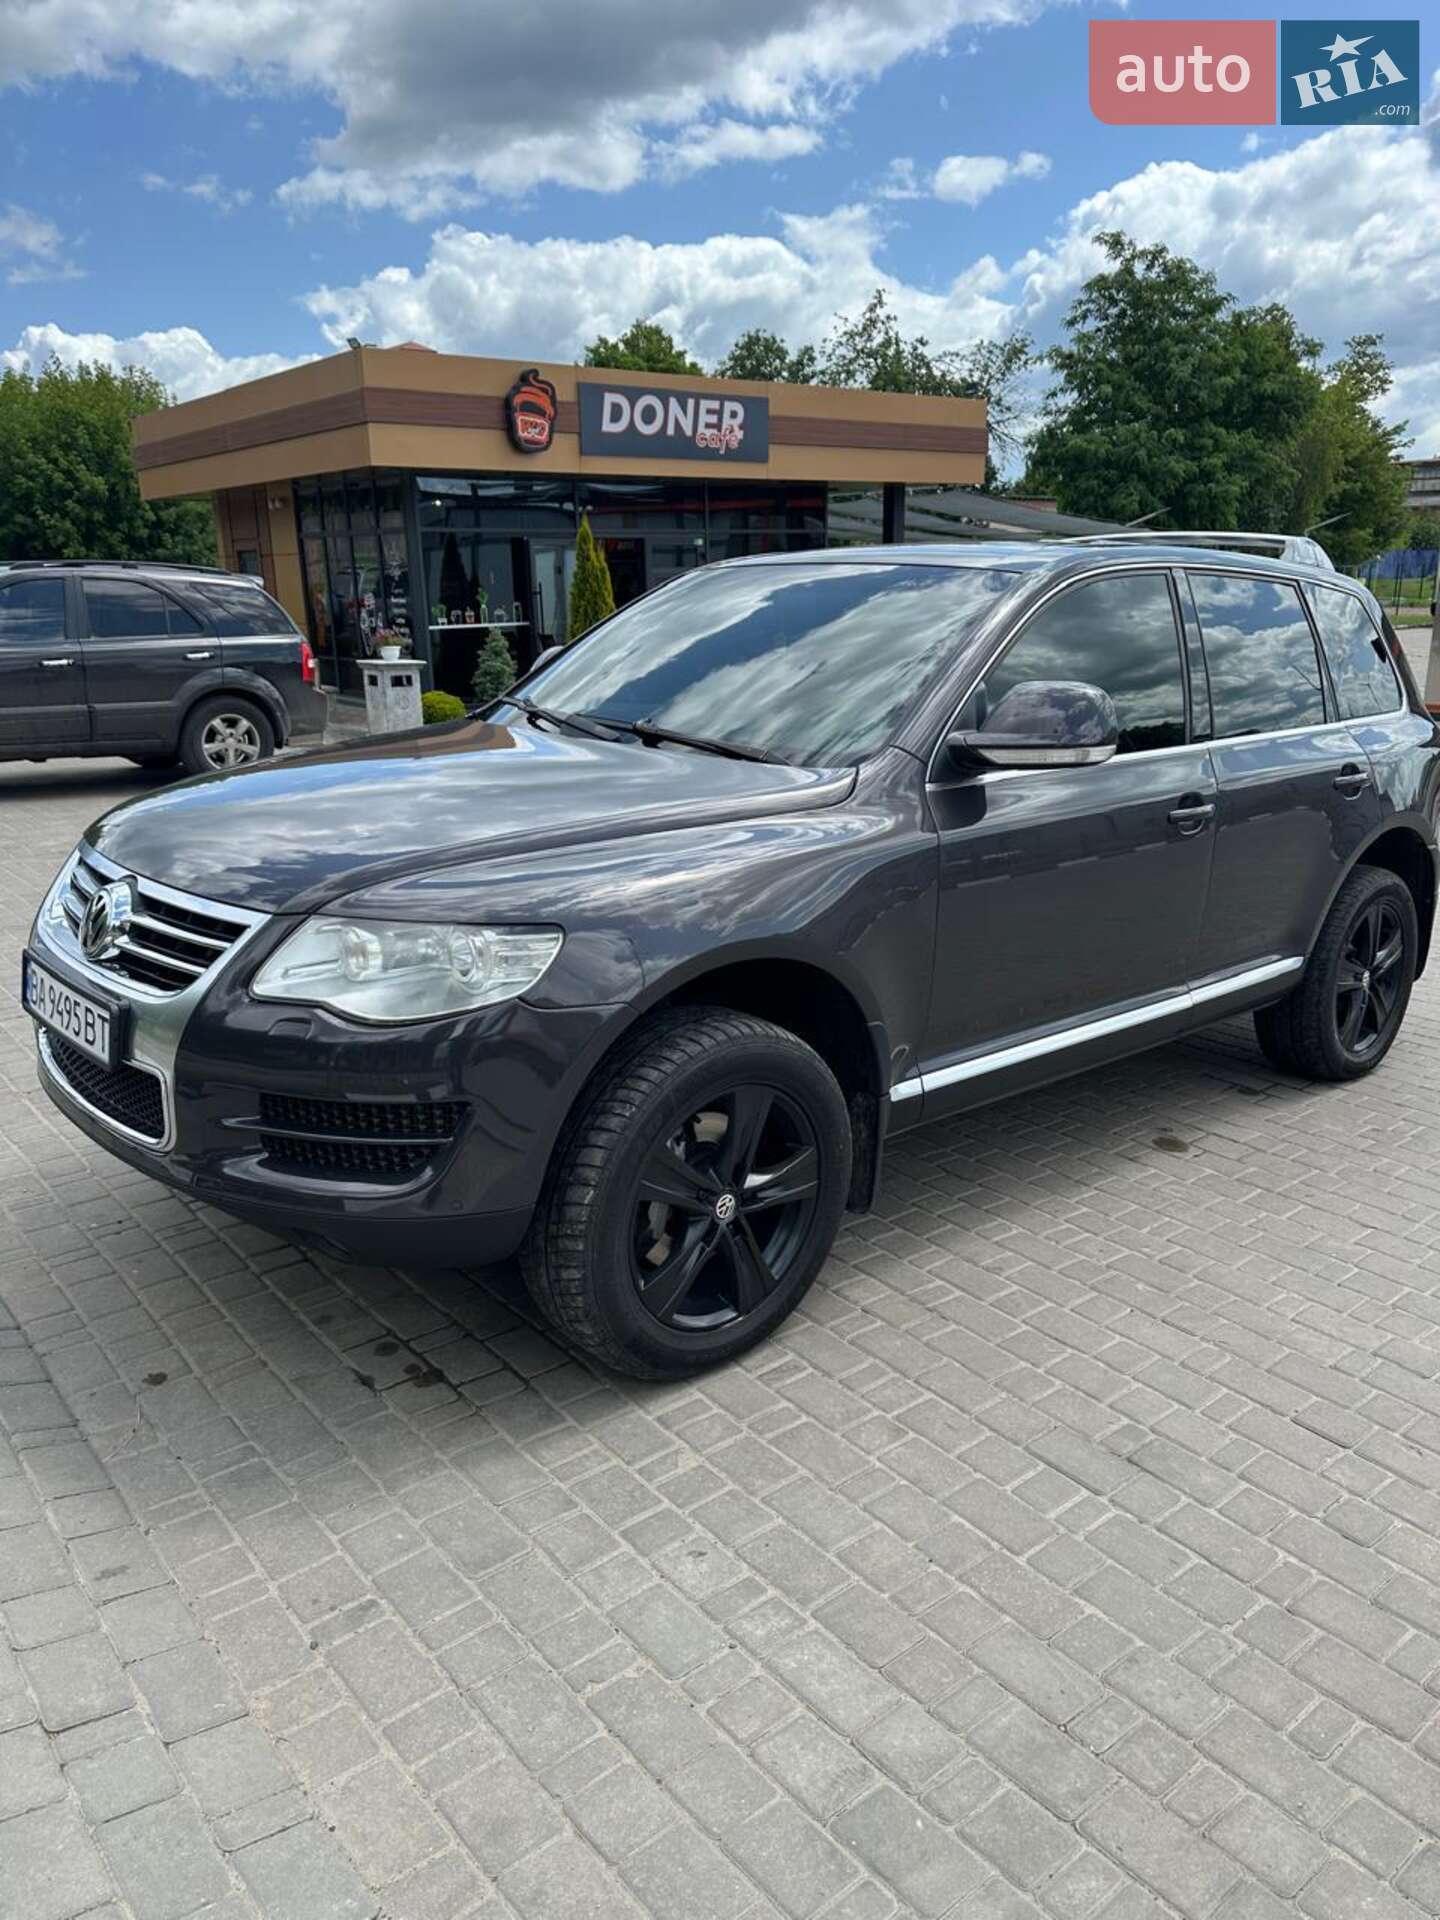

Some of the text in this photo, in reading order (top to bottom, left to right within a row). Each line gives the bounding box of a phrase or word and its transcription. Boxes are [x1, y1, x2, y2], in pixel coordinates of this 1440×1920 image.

[601, 391, 745, 439] DONER
[30, 970, 109, 1054] BA 9495 BT
